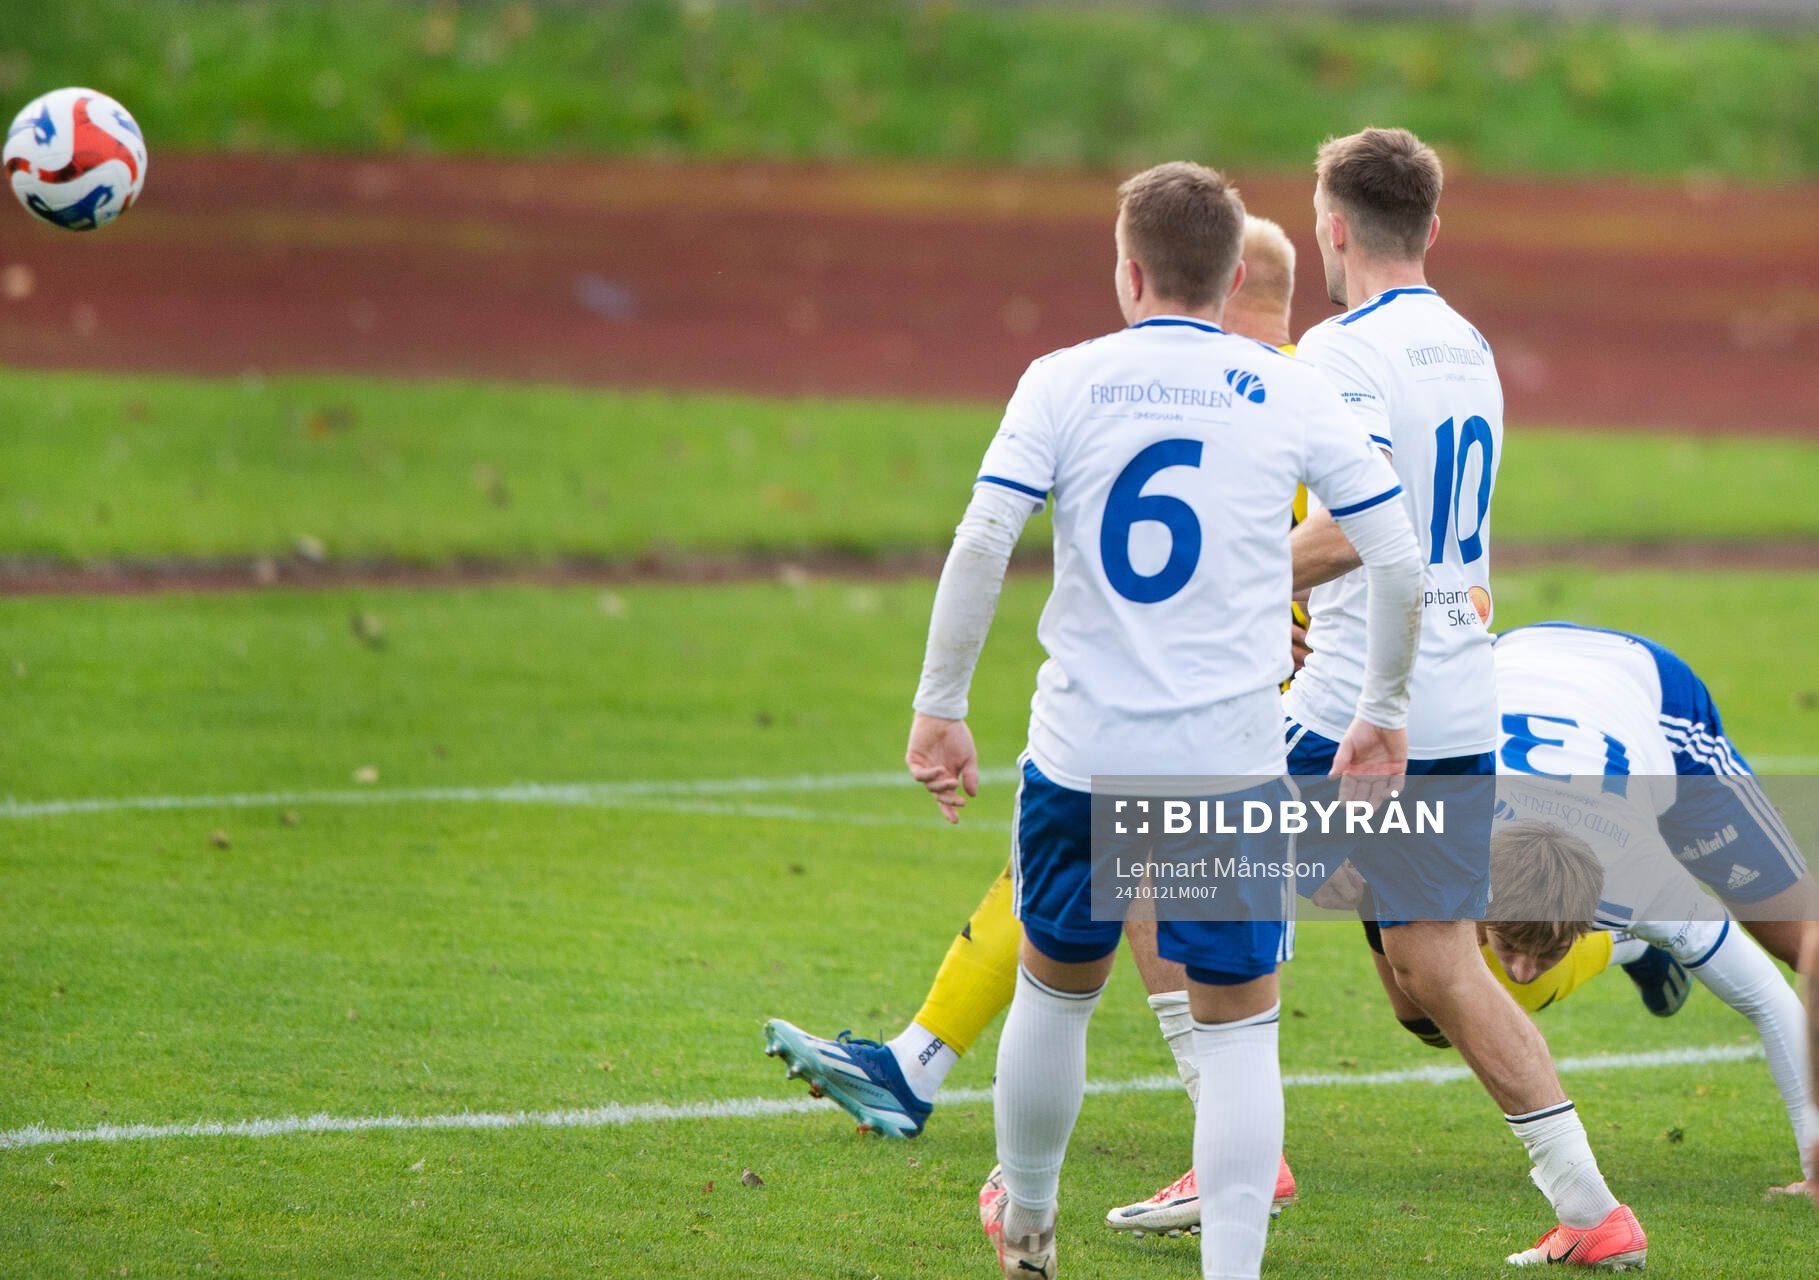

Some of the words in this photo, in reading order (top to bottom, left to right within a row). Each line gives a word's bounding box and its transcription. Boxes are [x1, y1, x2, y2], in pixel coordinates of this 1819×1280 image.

[1090, 383, 1144, 405] FRITID
[1147, 379, 1232, 409] ÖSTERLEN
[1427, 415, 1493, 565] 10
[1100, 438, 1204, 605] 6
[1500, 712, 1631, 800] 13
[1584, 812, 1631, 849] FRITID
[1721, 823, 1739, 844] AB
